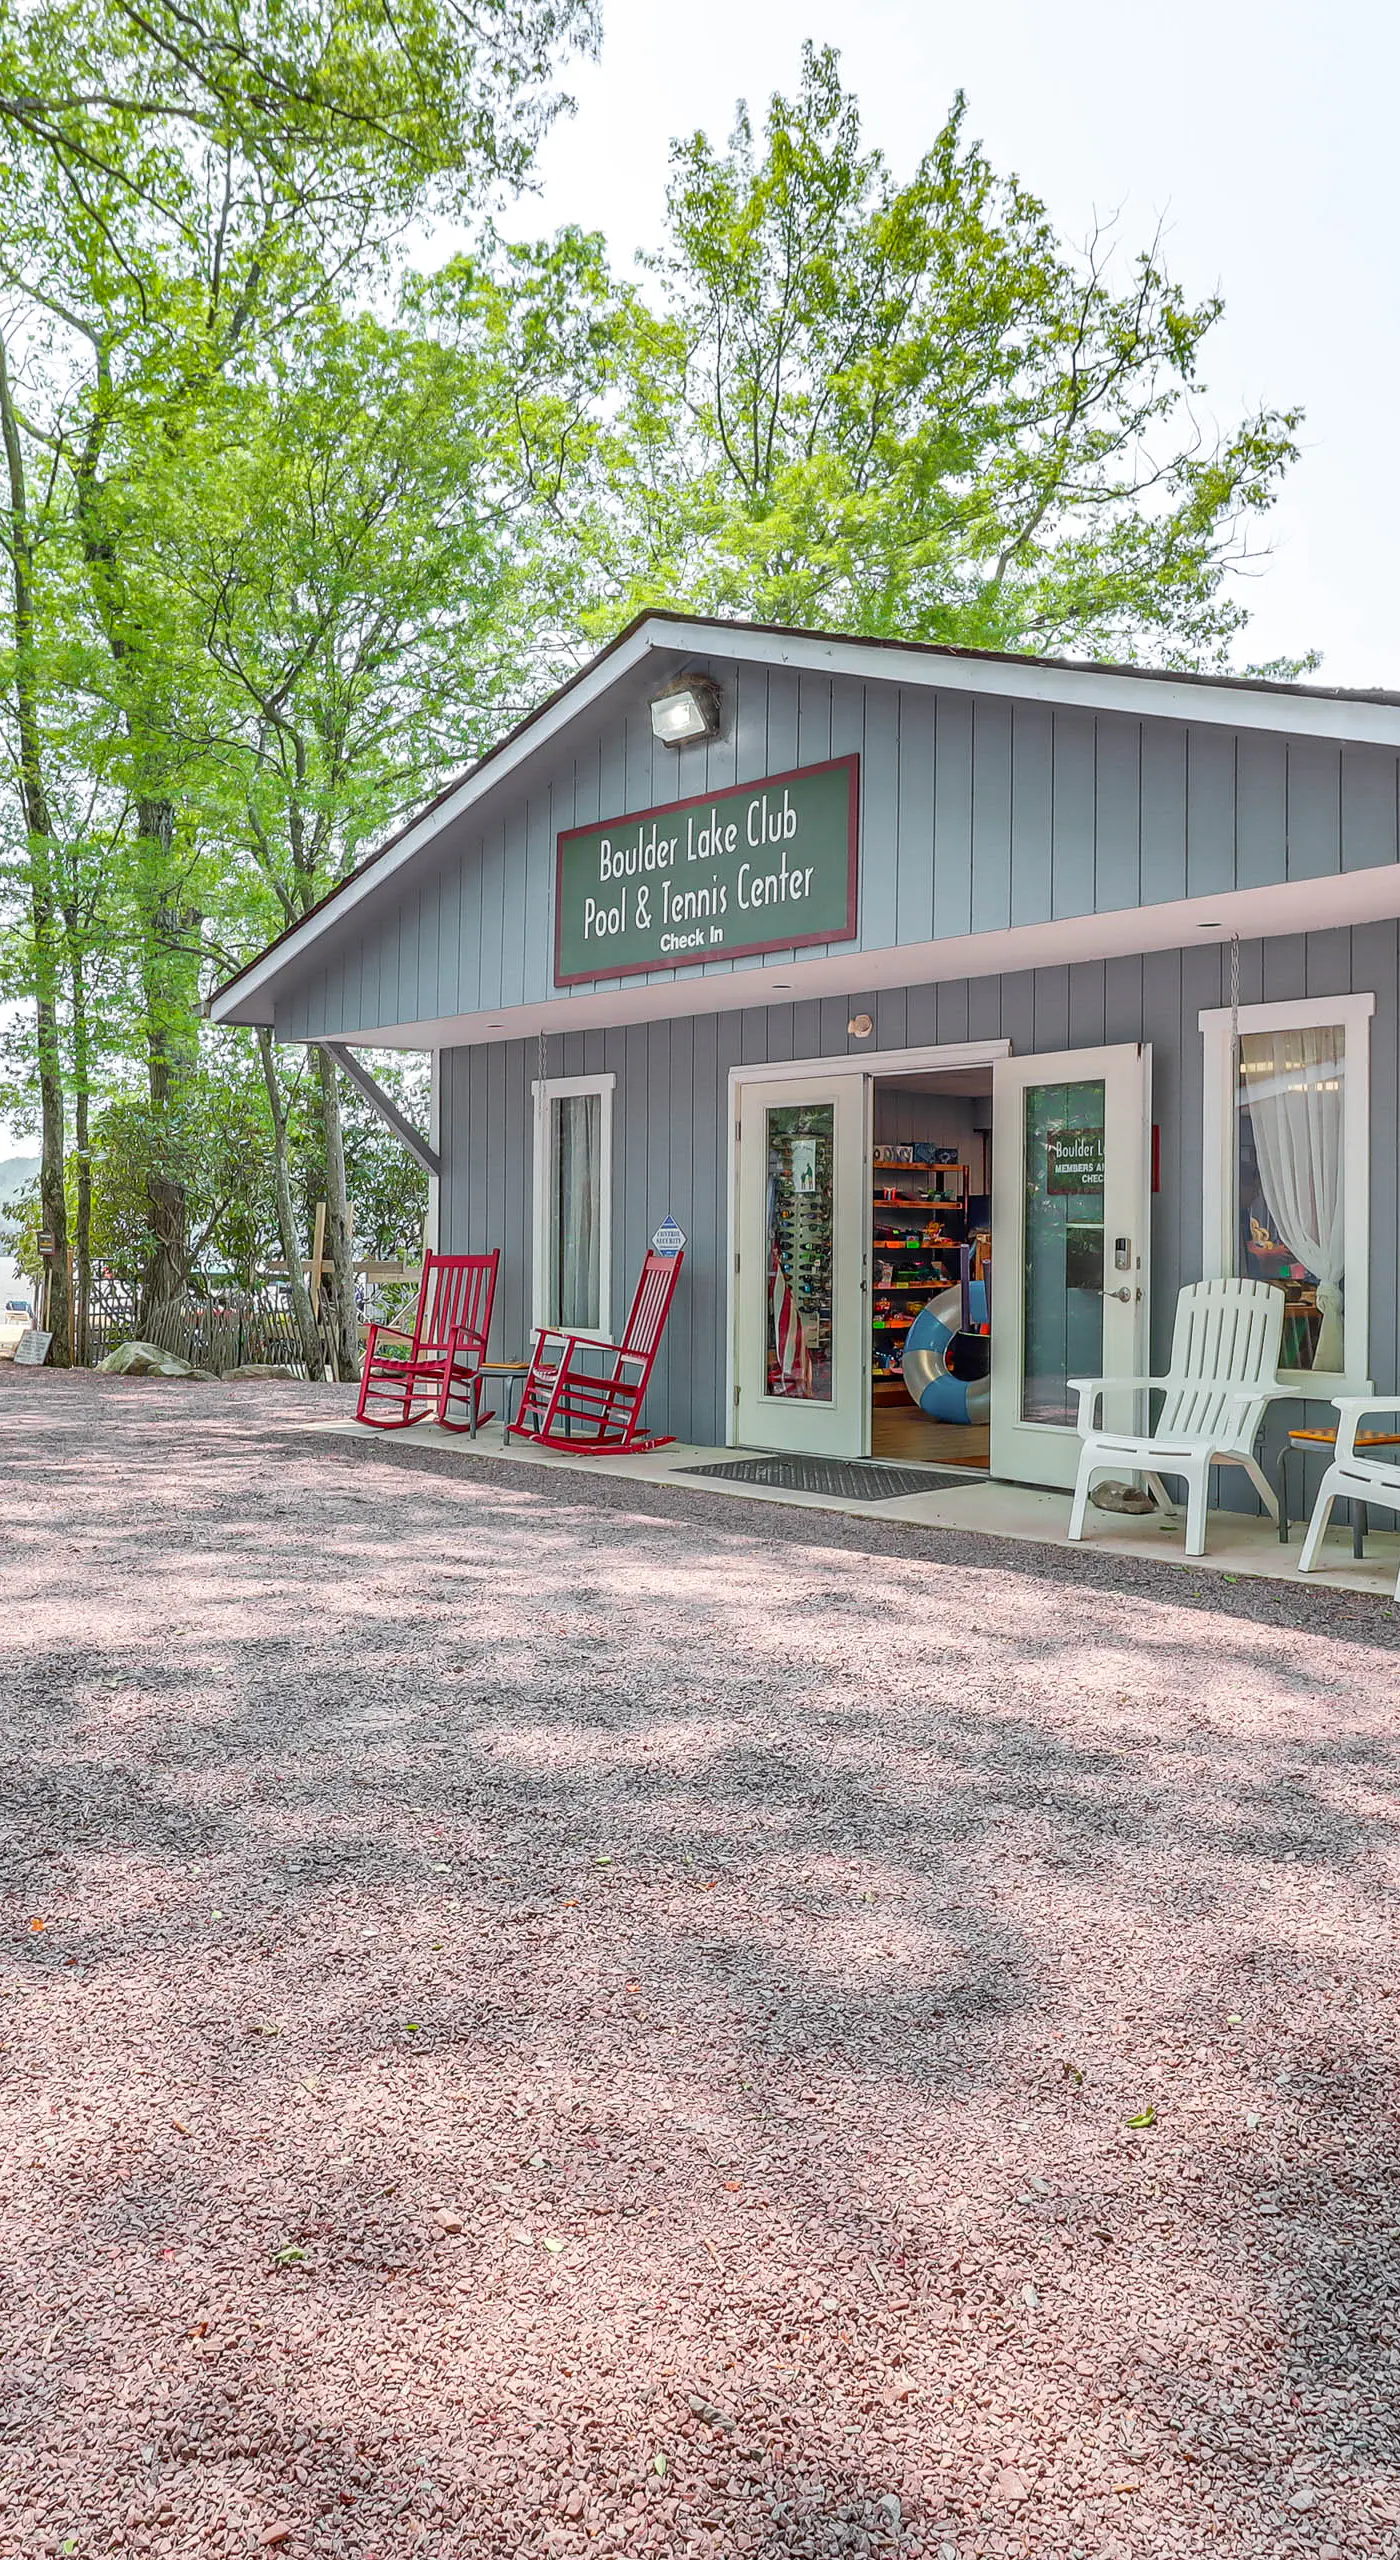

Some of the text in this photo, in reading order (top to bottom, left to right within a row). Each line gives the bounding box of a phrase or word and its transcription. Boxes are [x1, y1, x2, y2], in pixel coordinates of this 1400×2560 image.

[600, 789, 797, 882] Boulder Lake Club
[584, 852, 814, 939] Pool & Tennis Center
[660, 925, 724, 952] Check In
[1056, 1139, 1094, 1157] Boulder
[1055, 1163, 1093, 1173] MEMBERS
